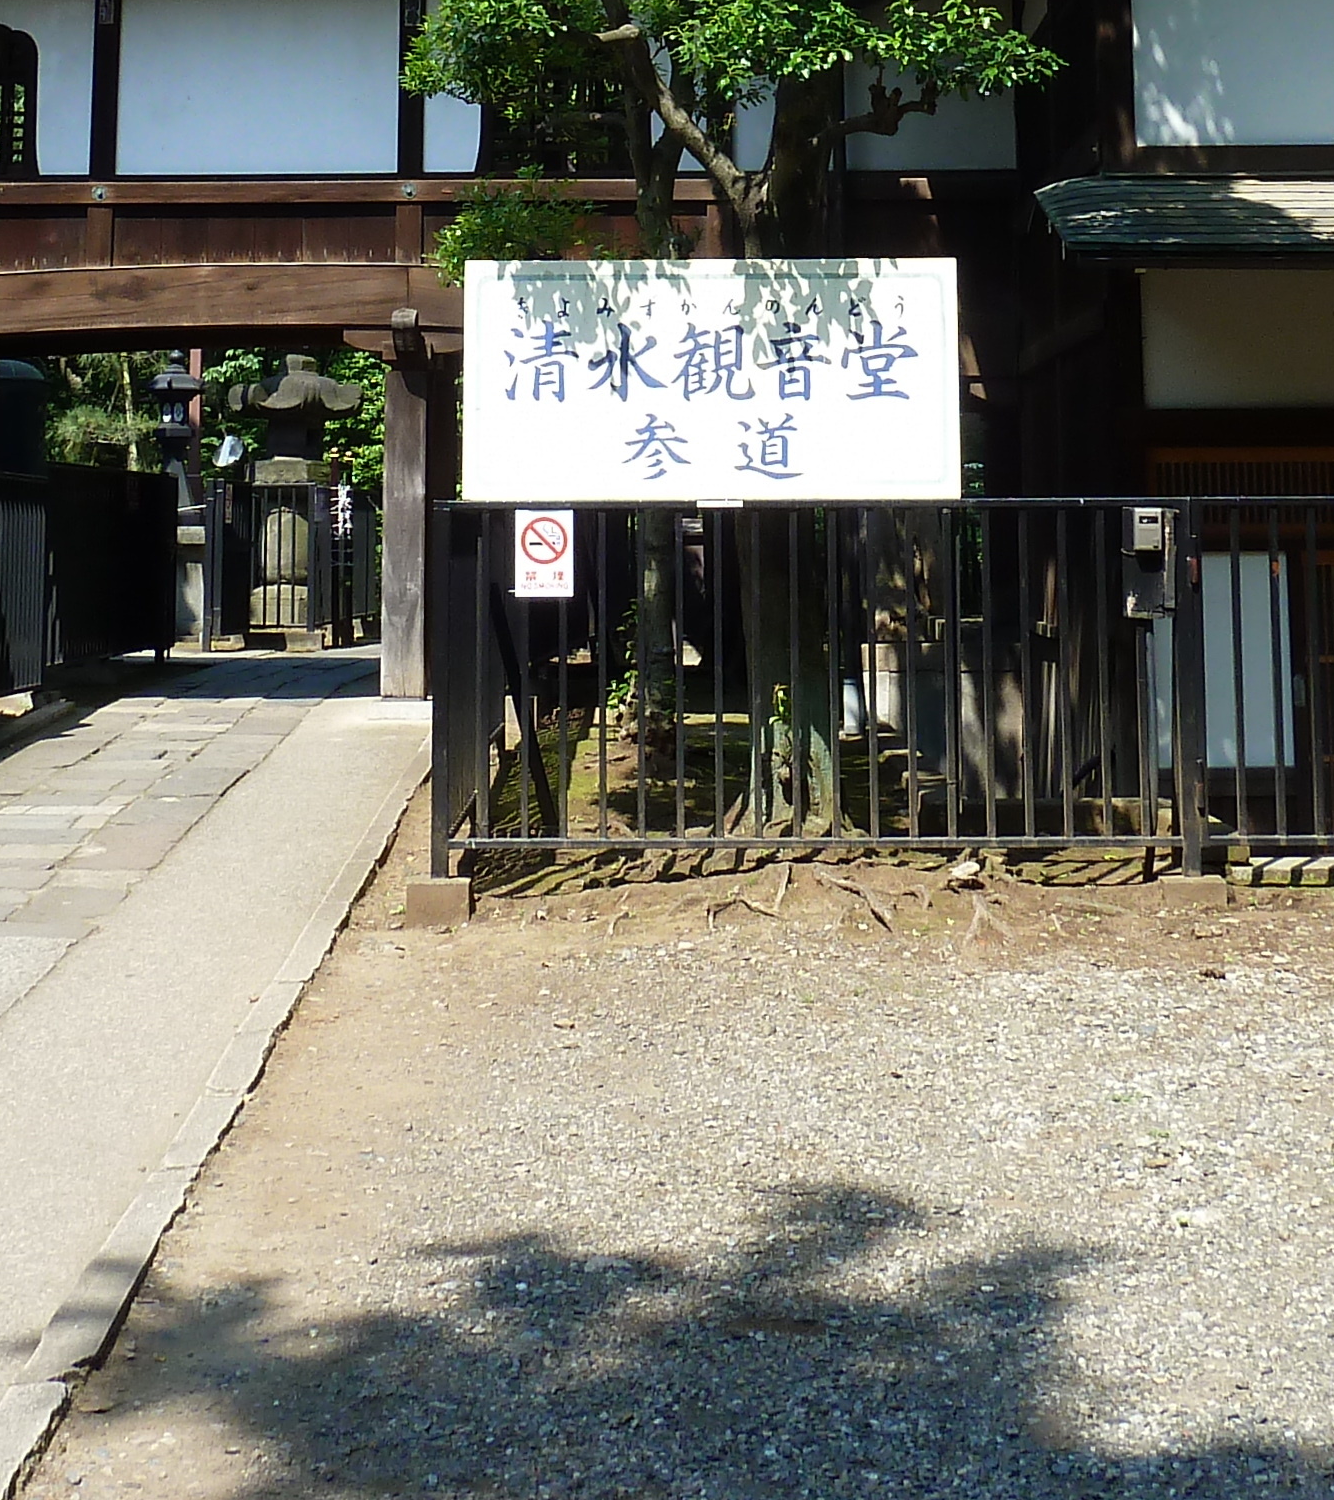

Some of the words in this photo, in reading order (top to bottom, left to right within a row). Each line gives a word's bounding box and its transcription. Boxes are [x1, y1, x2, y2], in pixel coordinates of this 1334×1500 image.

[503, 320, 919, 403] 清水観音堂
[622, 413, 804, 480] 参道
